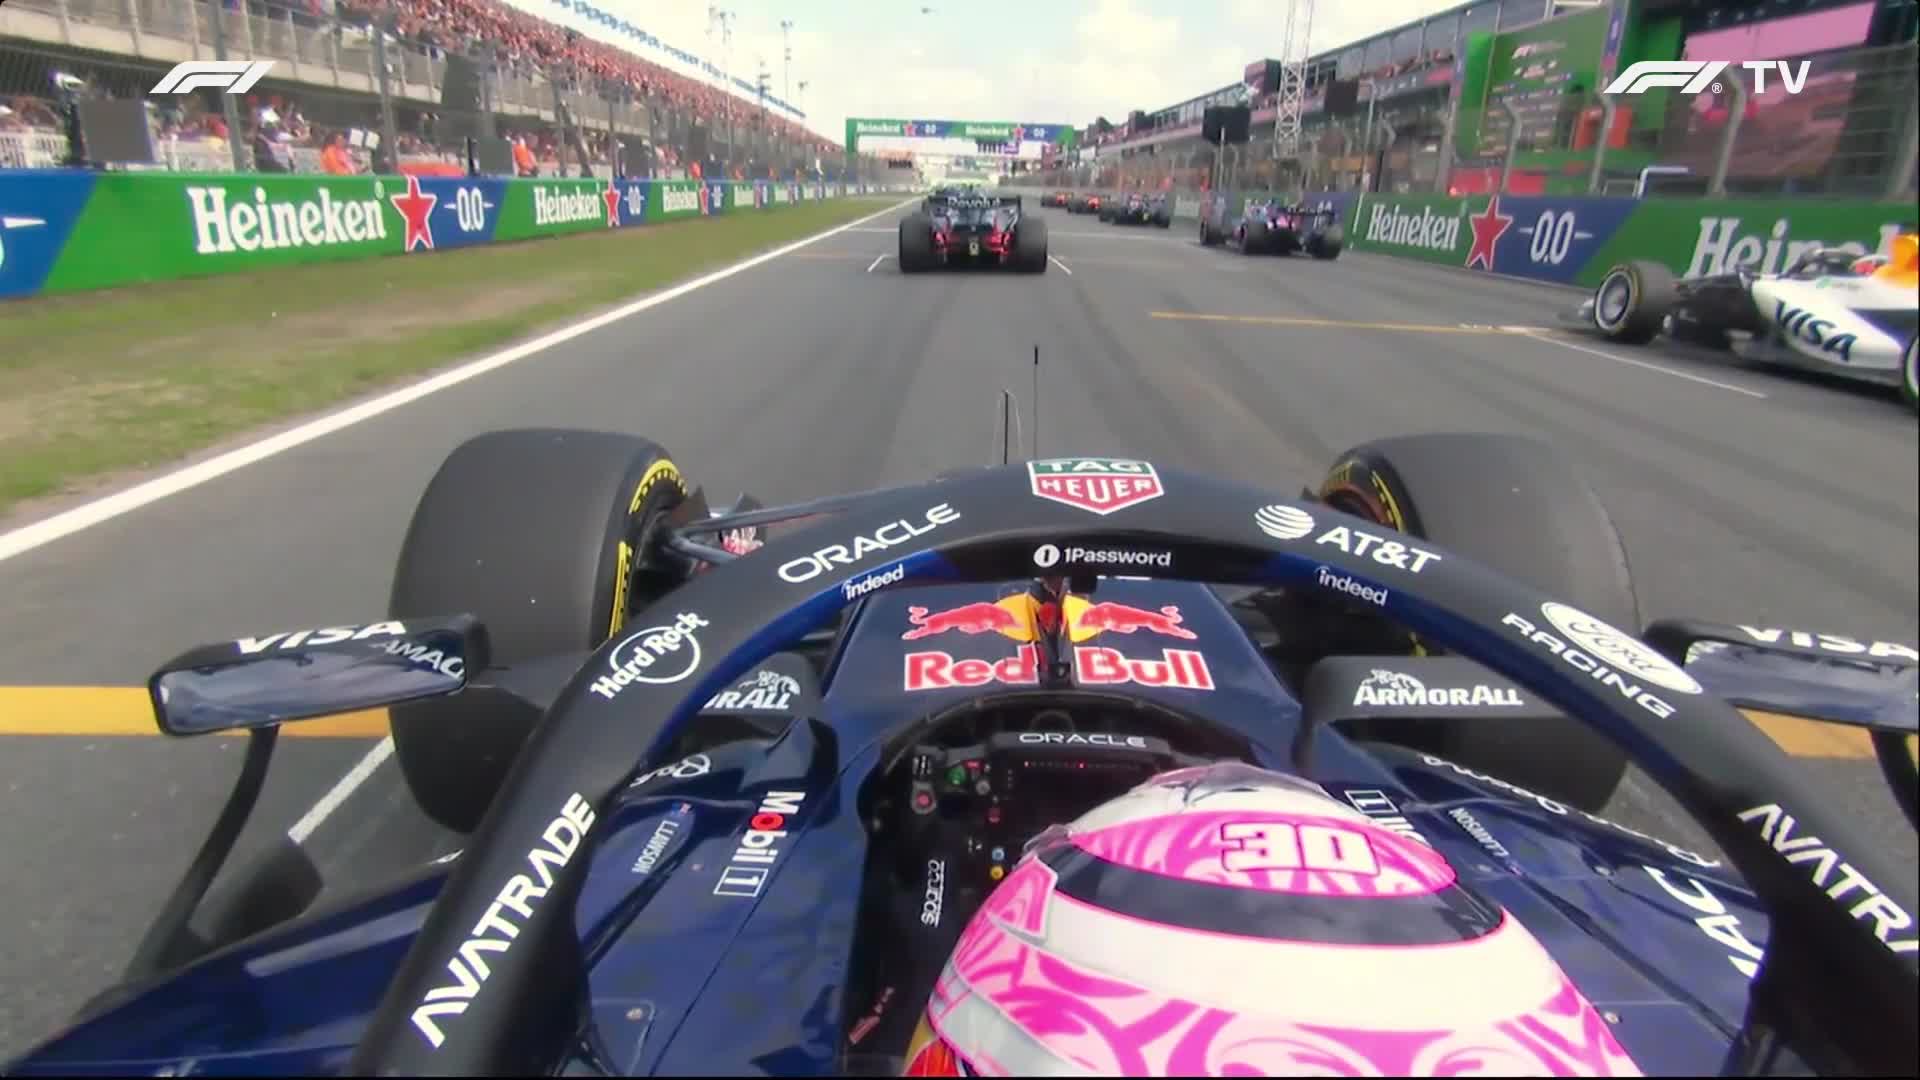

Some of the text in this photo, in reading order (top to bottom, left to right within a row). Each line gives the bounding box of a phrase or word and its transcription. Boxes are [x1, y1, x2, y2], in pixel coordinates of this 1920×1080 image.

[186, 186, 387, 253] Heineken
[534, 185, 601, 225] Heineken
[1366, 203, 1460, 251] Heineken
[1775, 298, 1858, 361] VISA
[1040, 461, 1142, 473] TAG
[1041, 478, 1153, 503] HEUER
[778, 503, 961, 583] ORACLE
[1064, 547, 1172, 567] 1Password
[1316, 526, 1442, 574] AT&T
[844, 564, 905, 600] indeed
[1318, 567, 1388, 607] indeed
[237, 620, 406, 654] VISA
[590, 613, 709, 699] Hard Rock
[904, 643, 1215, 691] Red Bull
[1502, 613, 1677, 719] RACING
[1019, 732, 1146, 749] ORACLE
[731, 791, 806, 864] Mobil
[1221, 822, 1381, 877] 30
[921, 859, 945, 928] sparco
[410, 792, 596, 1050] AVATRADE
